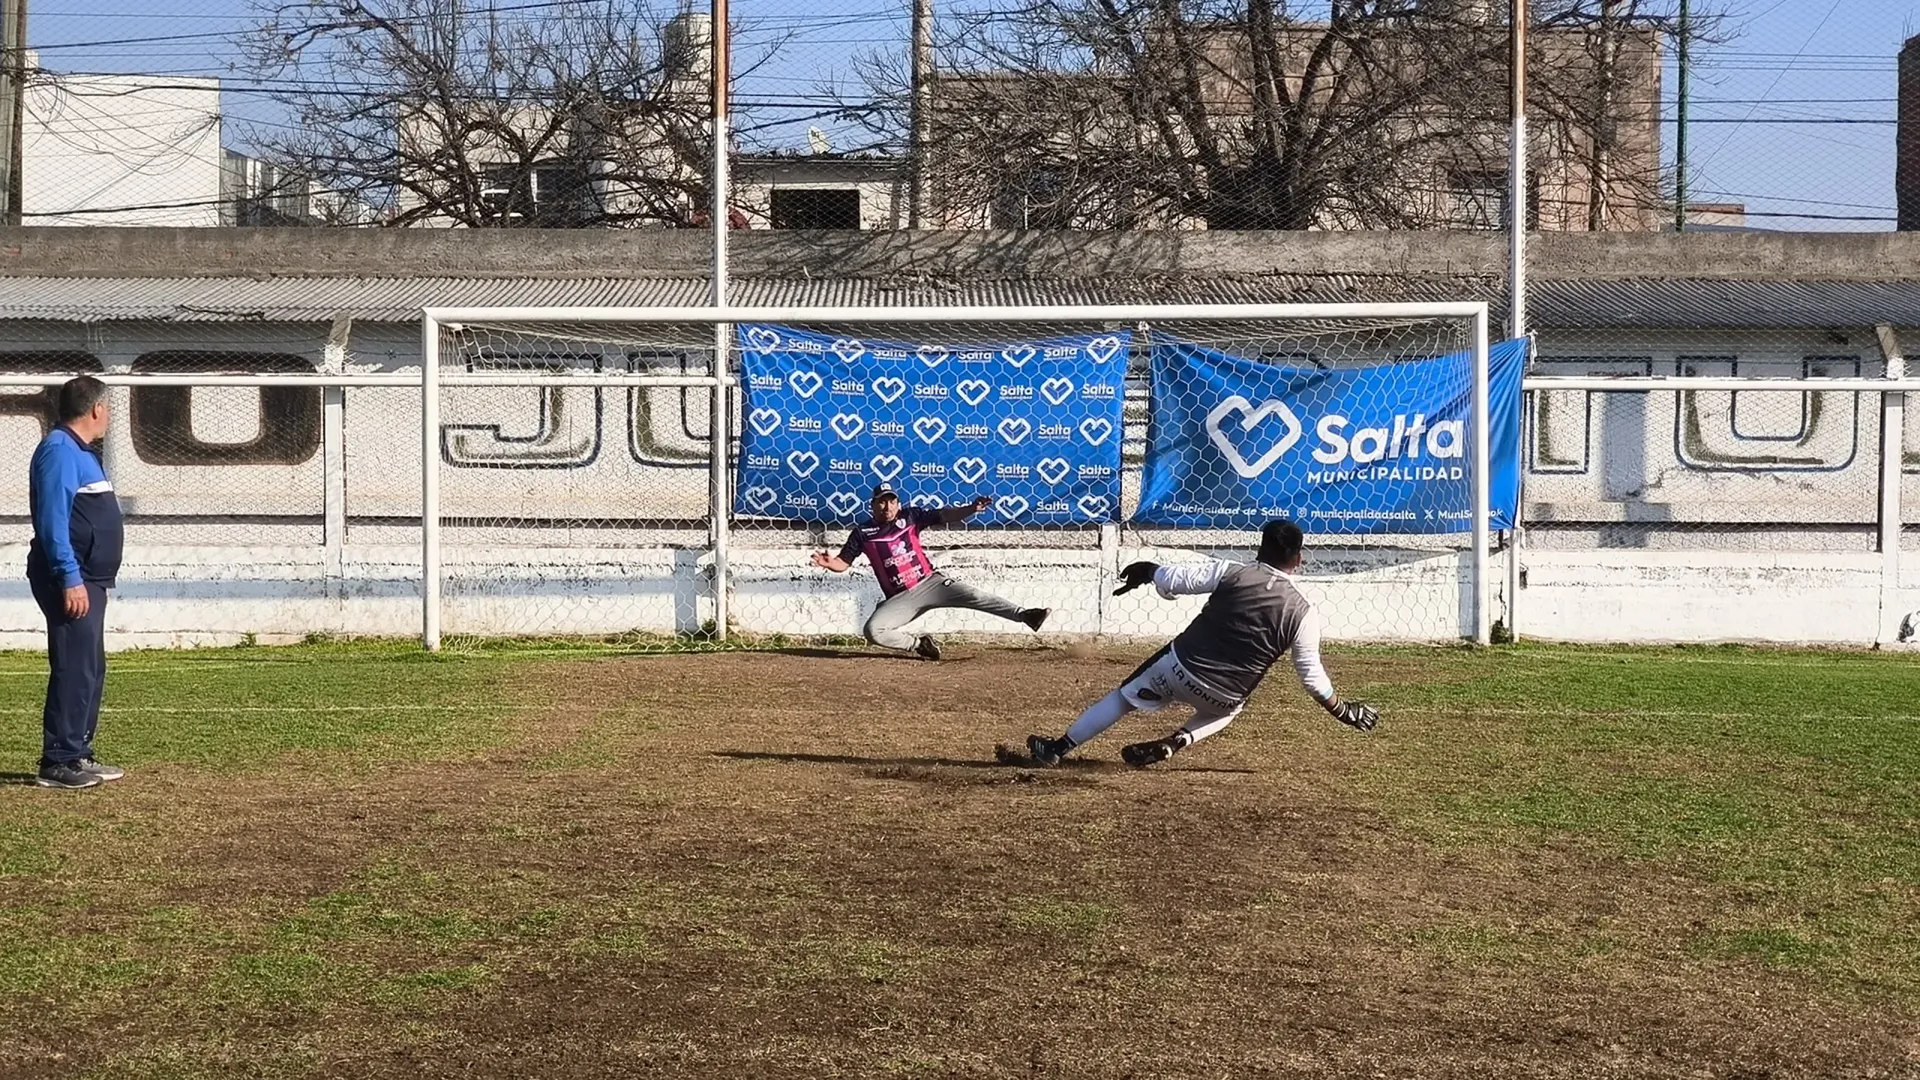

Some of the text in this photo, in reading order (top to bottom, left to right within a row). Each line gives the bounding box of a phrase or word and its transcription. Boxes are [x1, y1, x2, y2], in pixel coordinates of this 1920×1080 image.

[788, 338, 822, 351] Salta
[1043, 346, 1077, 359] Salta
[749, 374, 782, 387] Salta
[831, 380, 865, 392] Salta
[914, 384, 947, 396] Salta
[1000, 385, 1033, 396] Salta
[1082, 384, 1114, 395] Salta
[788, 416, 821, 429] Salta
[871, 421, 905, 433] Salta
[955, 424, 988, 436] Salta
[1038, 424, 1071, 436] Salta
[1310, 413, 1463, 464] Salta
[747, 454, 779, 467] Salta
[829, 459, 862, 471] Salta
[912, 462, 945, 473] Salta
[996, 463, 1029, 475] Salta
[1078, 464, 1111, 476] Salta
[1306, 466, 1464, 485] MUNICIPALIDAD
[785, 494, 817, 507] Salta
[1036, 501, 1069, 512] Salta
[1260, 507, 1290, 518] Salta
[1310, 508, 1417, 521] municipalidadsalta
